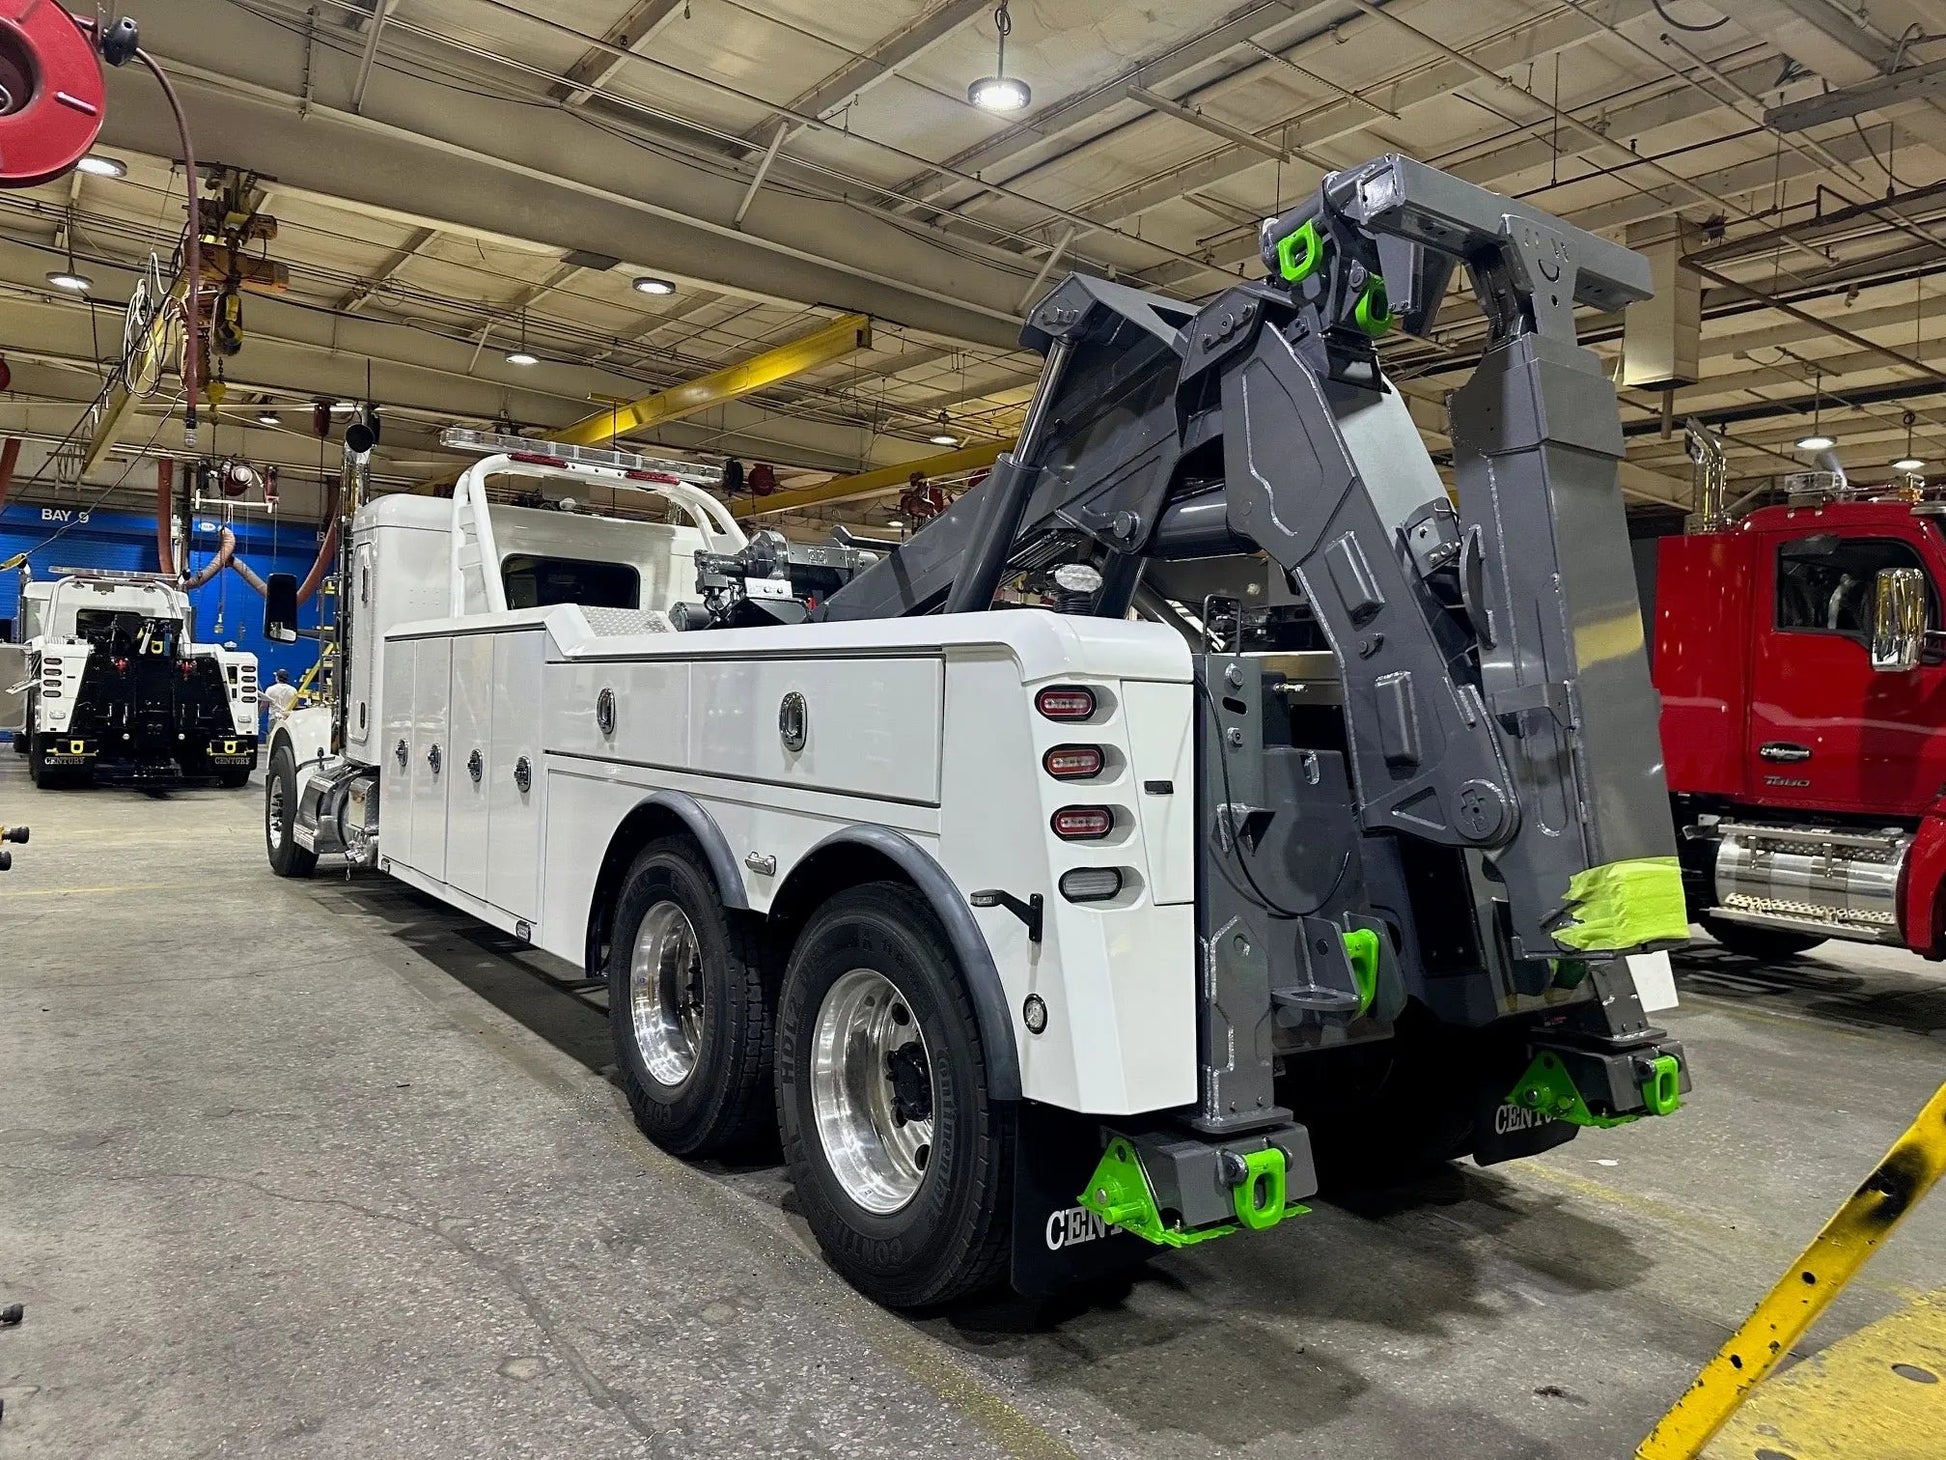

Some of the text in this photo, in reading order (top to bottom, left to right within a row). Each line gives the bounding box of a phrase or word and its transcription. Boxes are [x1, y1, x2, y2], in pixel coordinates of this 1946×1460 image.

[41, 508, 72, 522] BAY
[44, 756, 85, 765] CENTURY
[214, 756, 250, 765] CENTURY
